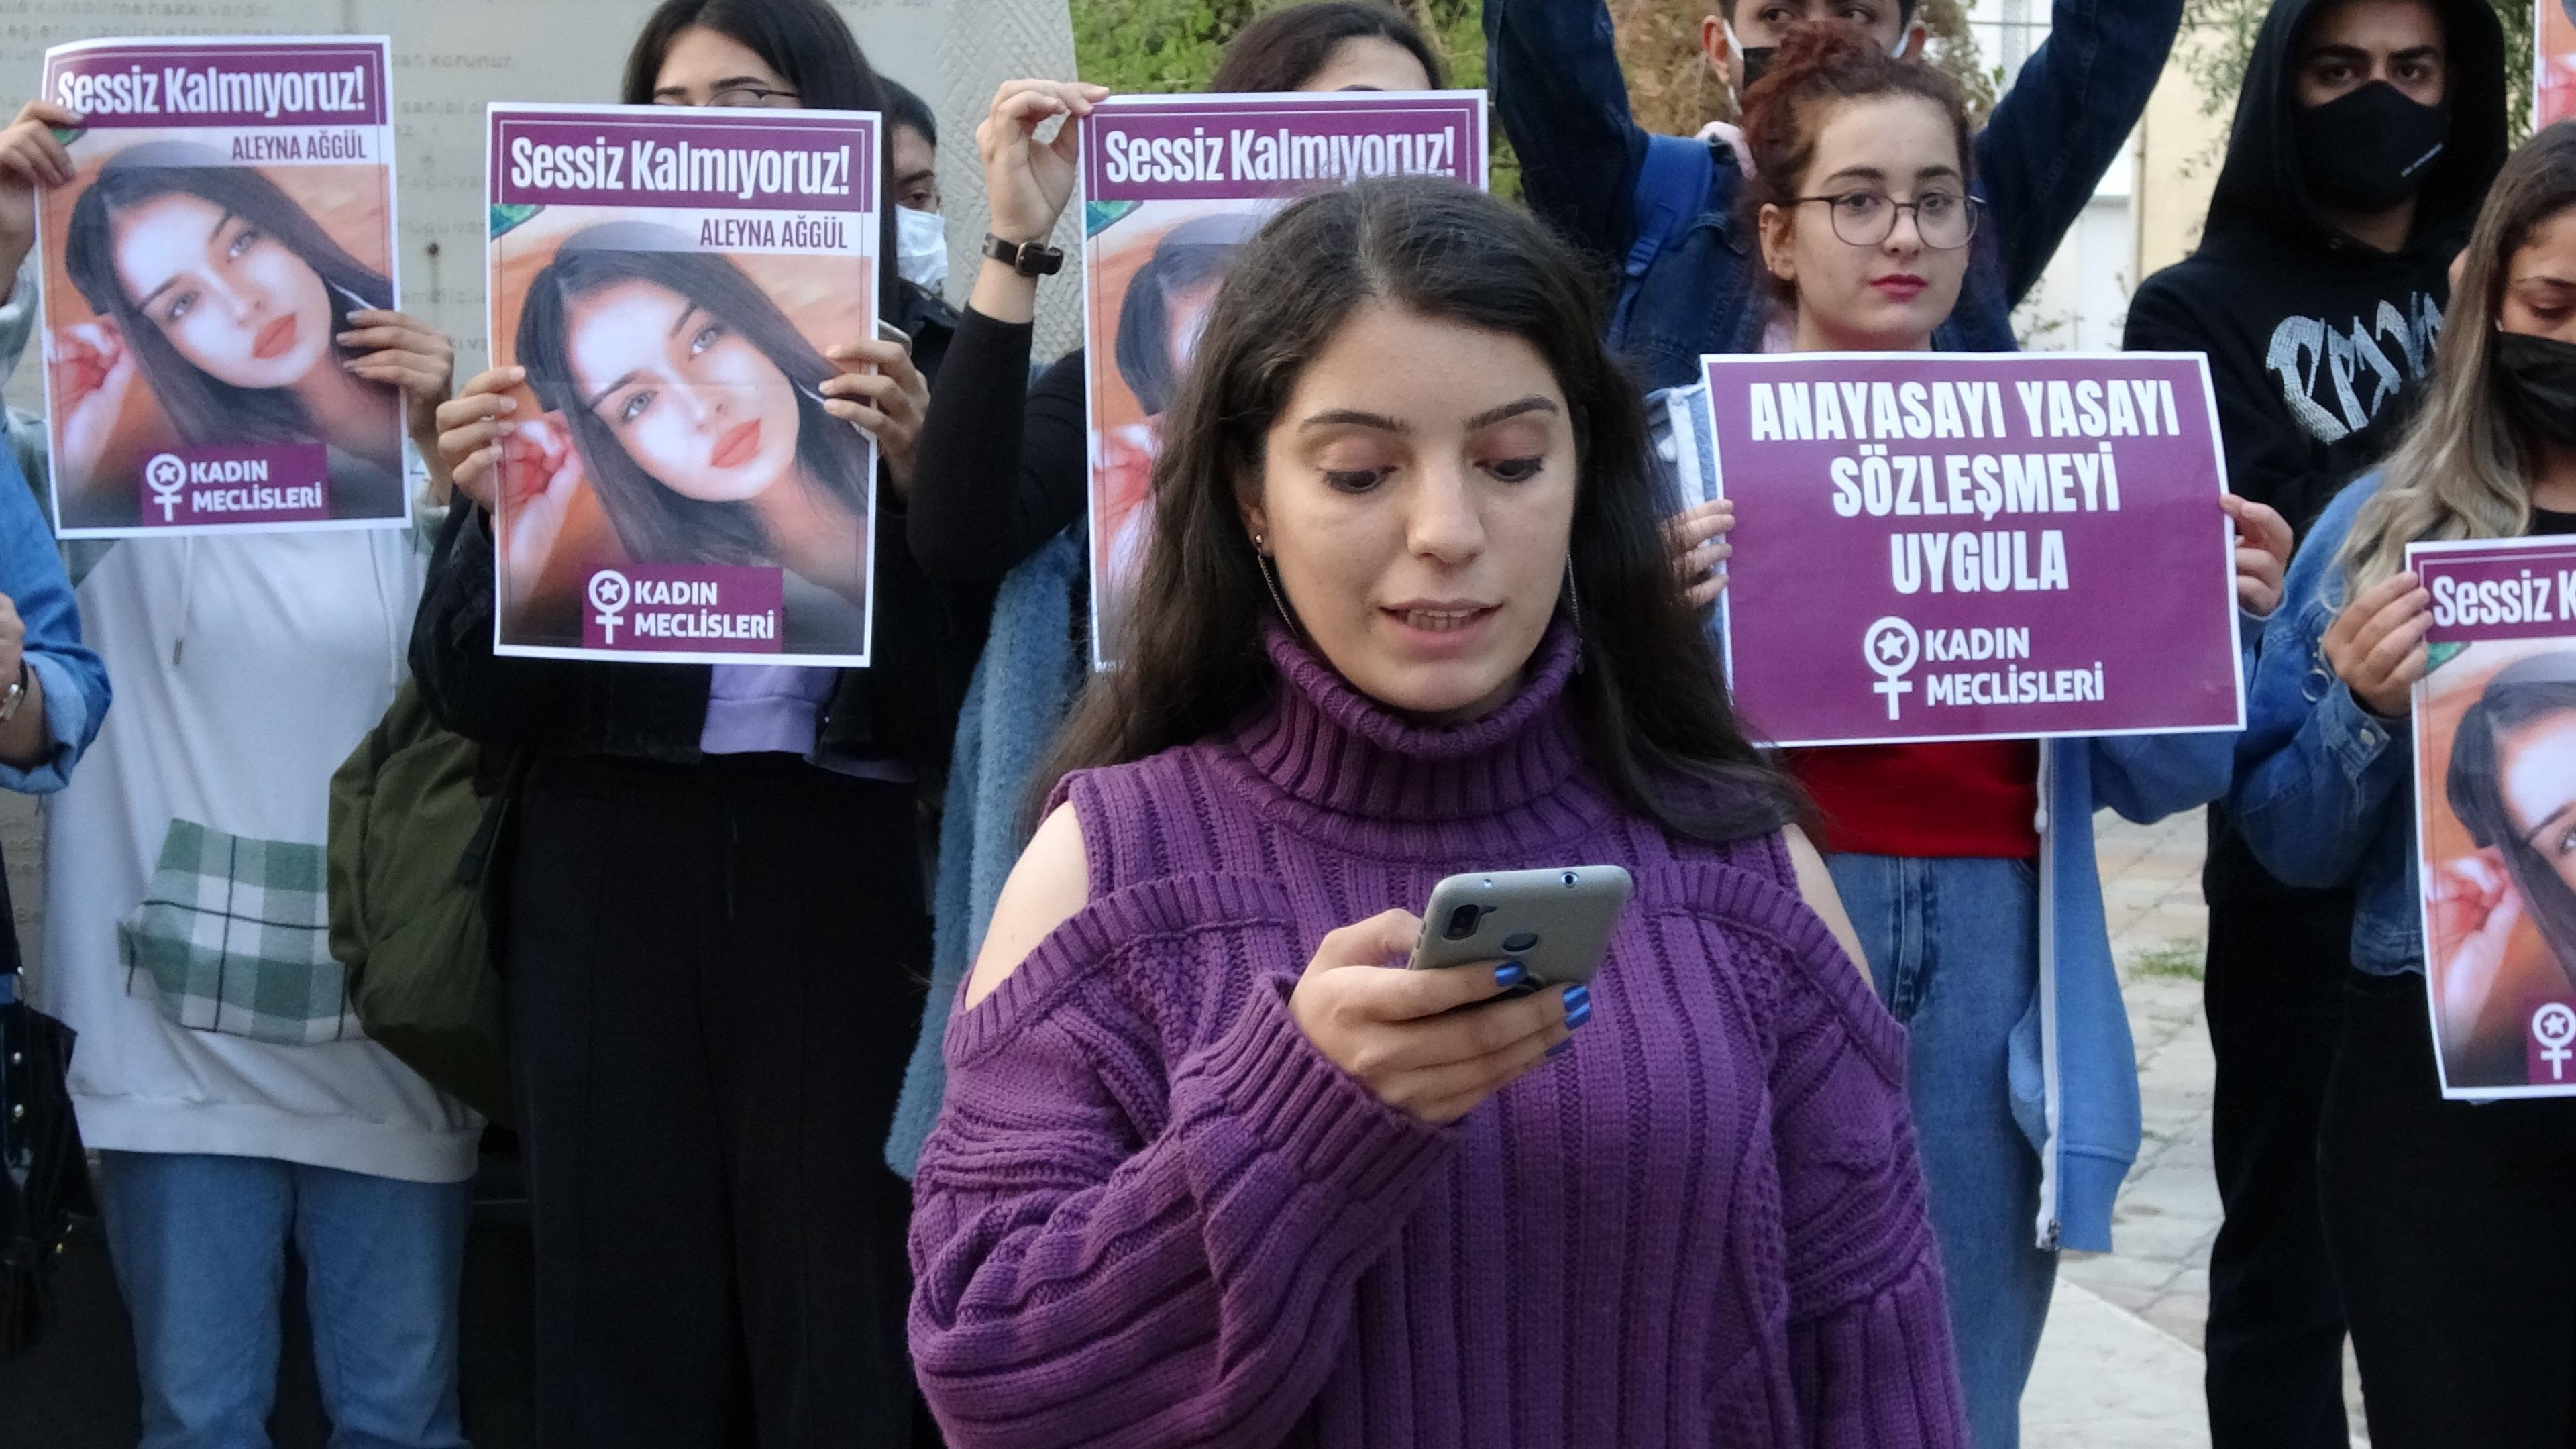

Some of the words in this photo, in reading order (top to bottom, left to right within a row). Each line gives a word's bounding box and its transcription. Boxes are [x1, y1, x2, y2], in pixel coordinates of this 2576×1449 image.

[57, 65, 160, 114] Sessiz
[164, 66, 366, 118] Kalmıyoruz!
[232, 136, 301, 162] ALEYNA
[307, 129, 367, 159] AĞGÜL
[511, 136, 625, 190] Sessiz
[631, 141, 850, 199] Kalmıyoruz!
[1106, 127, 1224, 182] Sessiz
[1230, 126, 1456, 184] Kalmıyoruz!
[700, 219, 775, 247] ALEYNA
[781, 214, 848, 249] AĞGÜL
[1750, 381, 2006, 441] ANAYASAYI
[2015, 379, 2180, 438] YASAYI
[191, 460, 268, 484] KADIN
[1830, 441, 2120, 521] SÖZLEŞMEYİ
[191, 480, 323, 513] MECLİSLERİ
[1890, 529, 2069, 594] UYGULA
[635, 581, 718, 606] KADIN
[2432, 569, 2553, 627] Sessiz
[635, 609, 775, 639] MECLİSLERİ
[1925, 627, 2029, 661] KADIN
[1926, 661, 2104, 706] MECLİSLERİ
